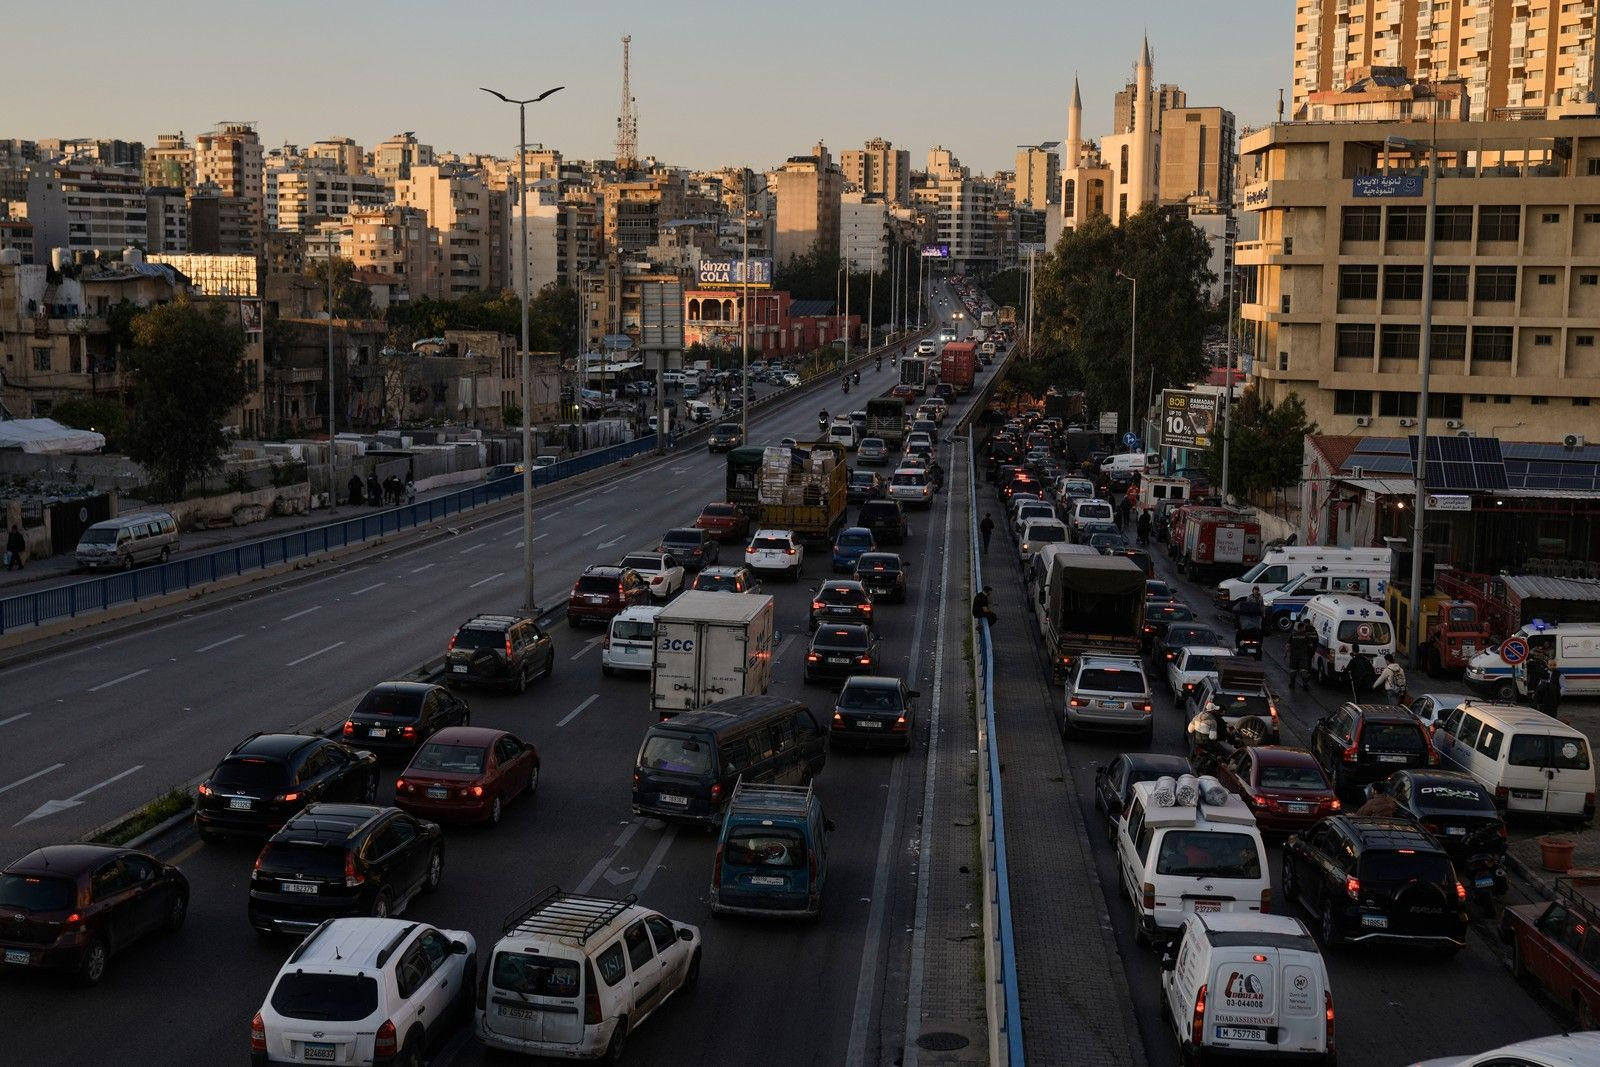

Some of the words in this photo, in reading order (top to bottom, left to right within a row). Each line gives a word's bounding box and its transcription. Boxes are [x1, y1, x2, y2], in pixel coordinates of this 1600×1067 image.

[700, 260, 730, 272] kinza
[700, 272, 730, 282] COLA
[1169, 398, 1185, 406] BOB
[1215, 1014, 1234, 1022] ROAD
[1235, 1015, 1274, 1024] ASSISTANCE
[1232, 1030, 1261, 1039] 757786
